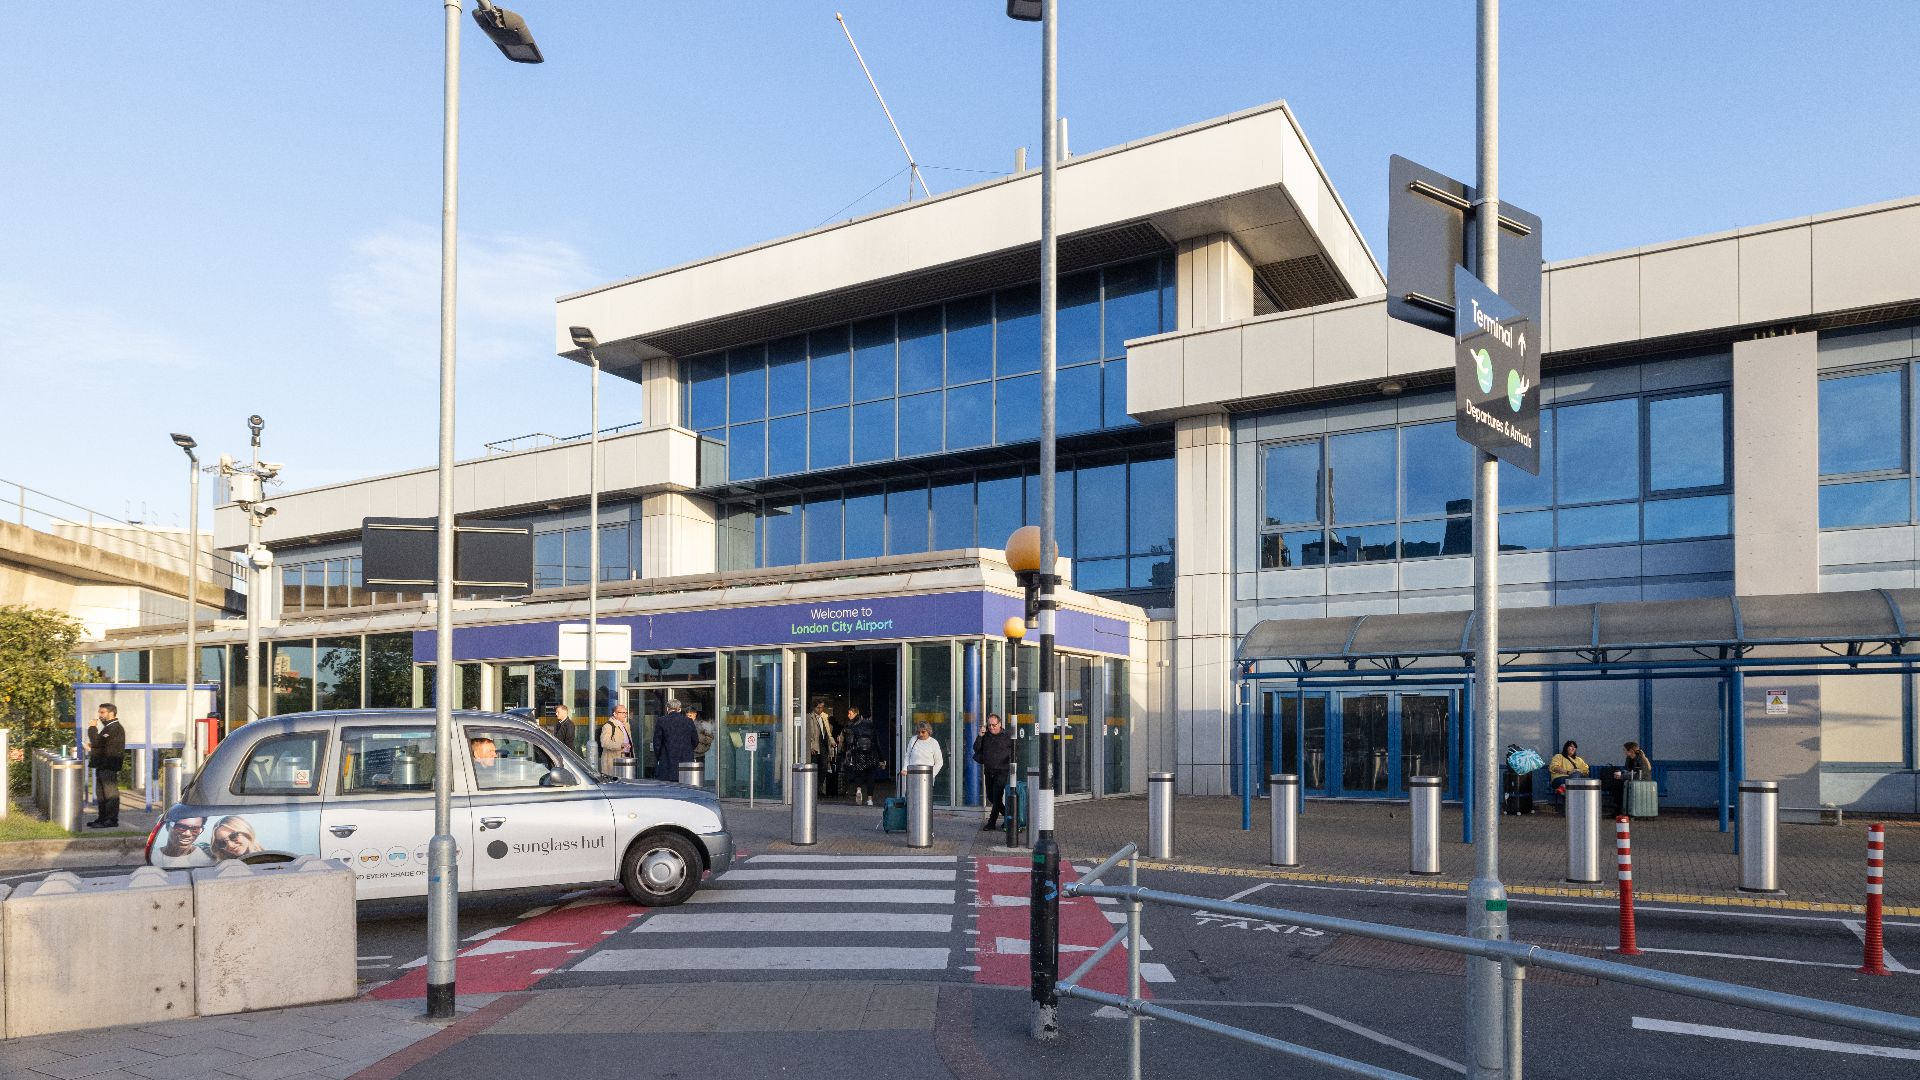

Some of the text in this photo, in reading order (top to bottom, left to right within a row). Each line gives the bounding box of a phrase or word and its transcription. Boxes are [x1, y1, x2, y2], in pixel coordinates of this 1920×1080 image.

[1472, 299, 1513, 349] Terminal
[1466, 399, 1532, 449] Departures & Arrivals
[810, 607, 873, 620] Welcome to
[791, 619, 893, 635] London City Airport
[512, 836, 605, 856] sunglass hut
[366, 872, 388, 880] EVERY
[390, 870, 414, 878] SHADE
[1195, 916, 1325, 937] TAXIS
